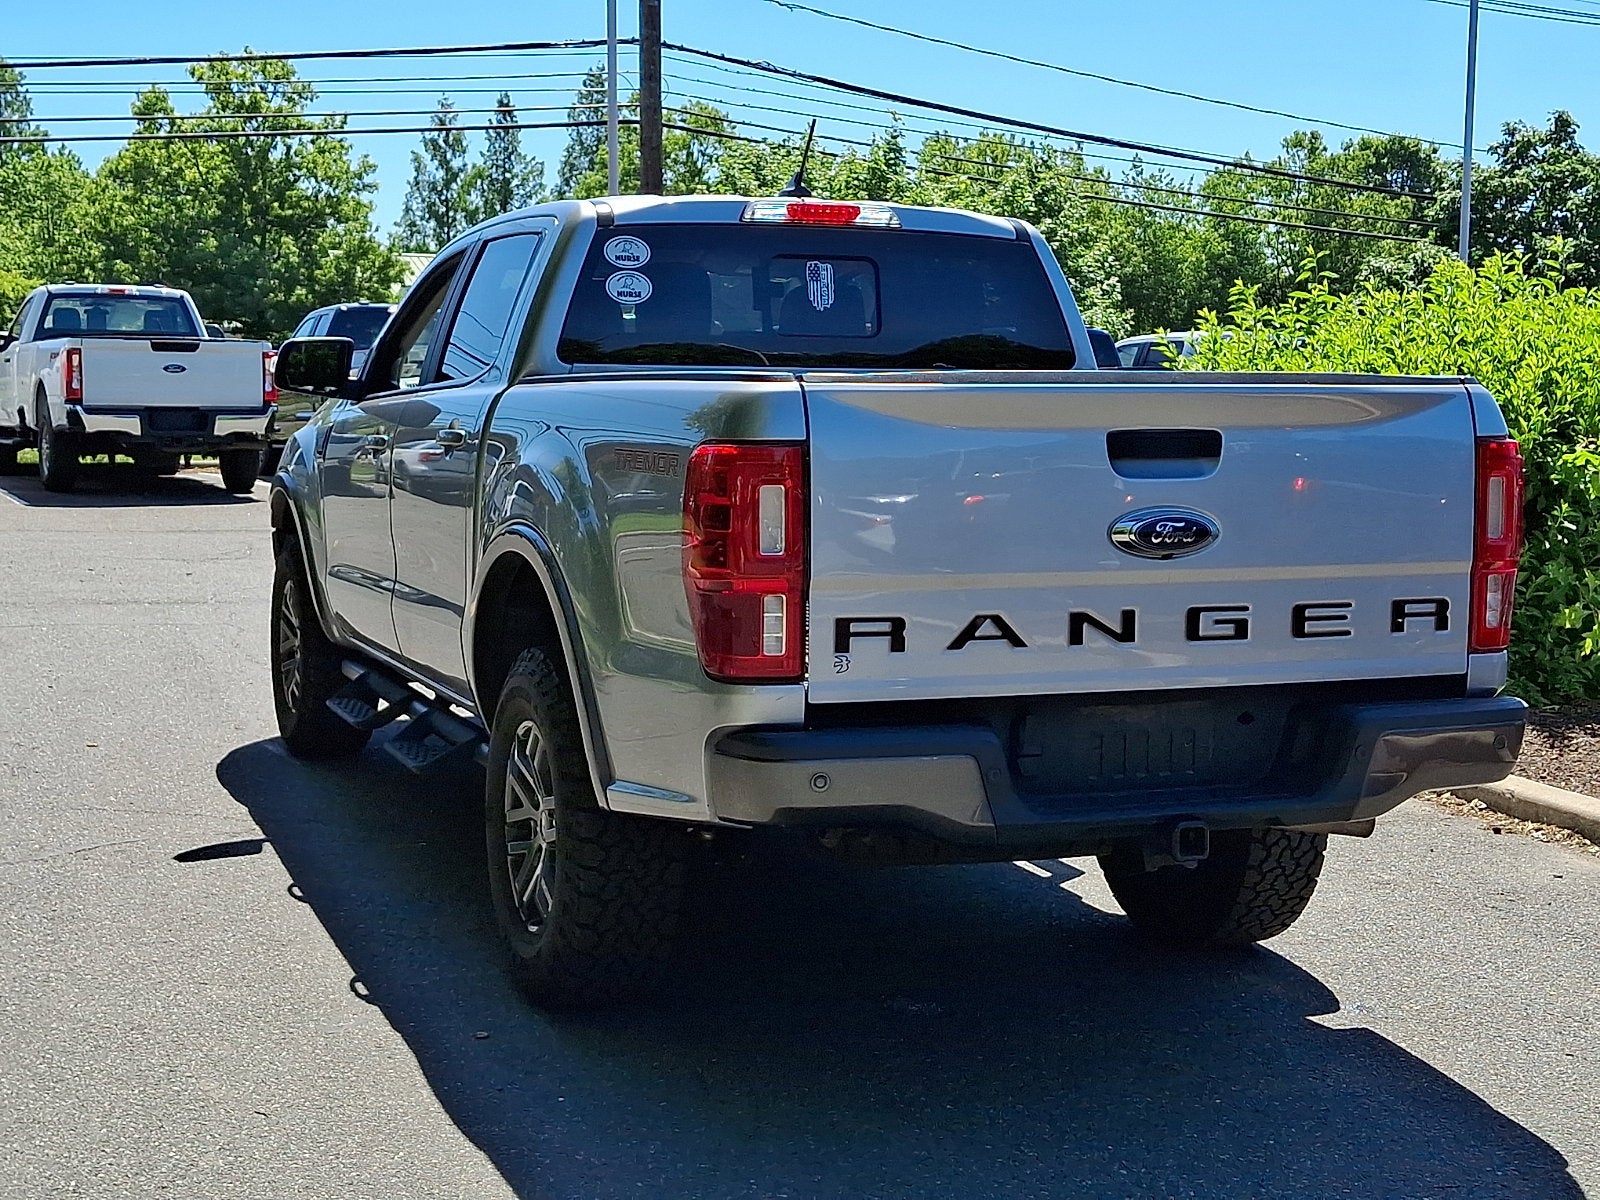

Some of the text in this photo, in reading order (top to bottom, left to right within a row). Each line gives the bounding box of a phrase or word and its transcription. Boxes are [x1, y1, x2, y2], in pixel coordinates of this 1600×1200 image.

[614, 254, 641, 262] NURSE
[616, 290, 642, 298] NURSE
[614, 447, 680, 478] TREMOR
[1151, 521, 1197, 544] Ford
[834, 598, 1451, 654] RANGER
